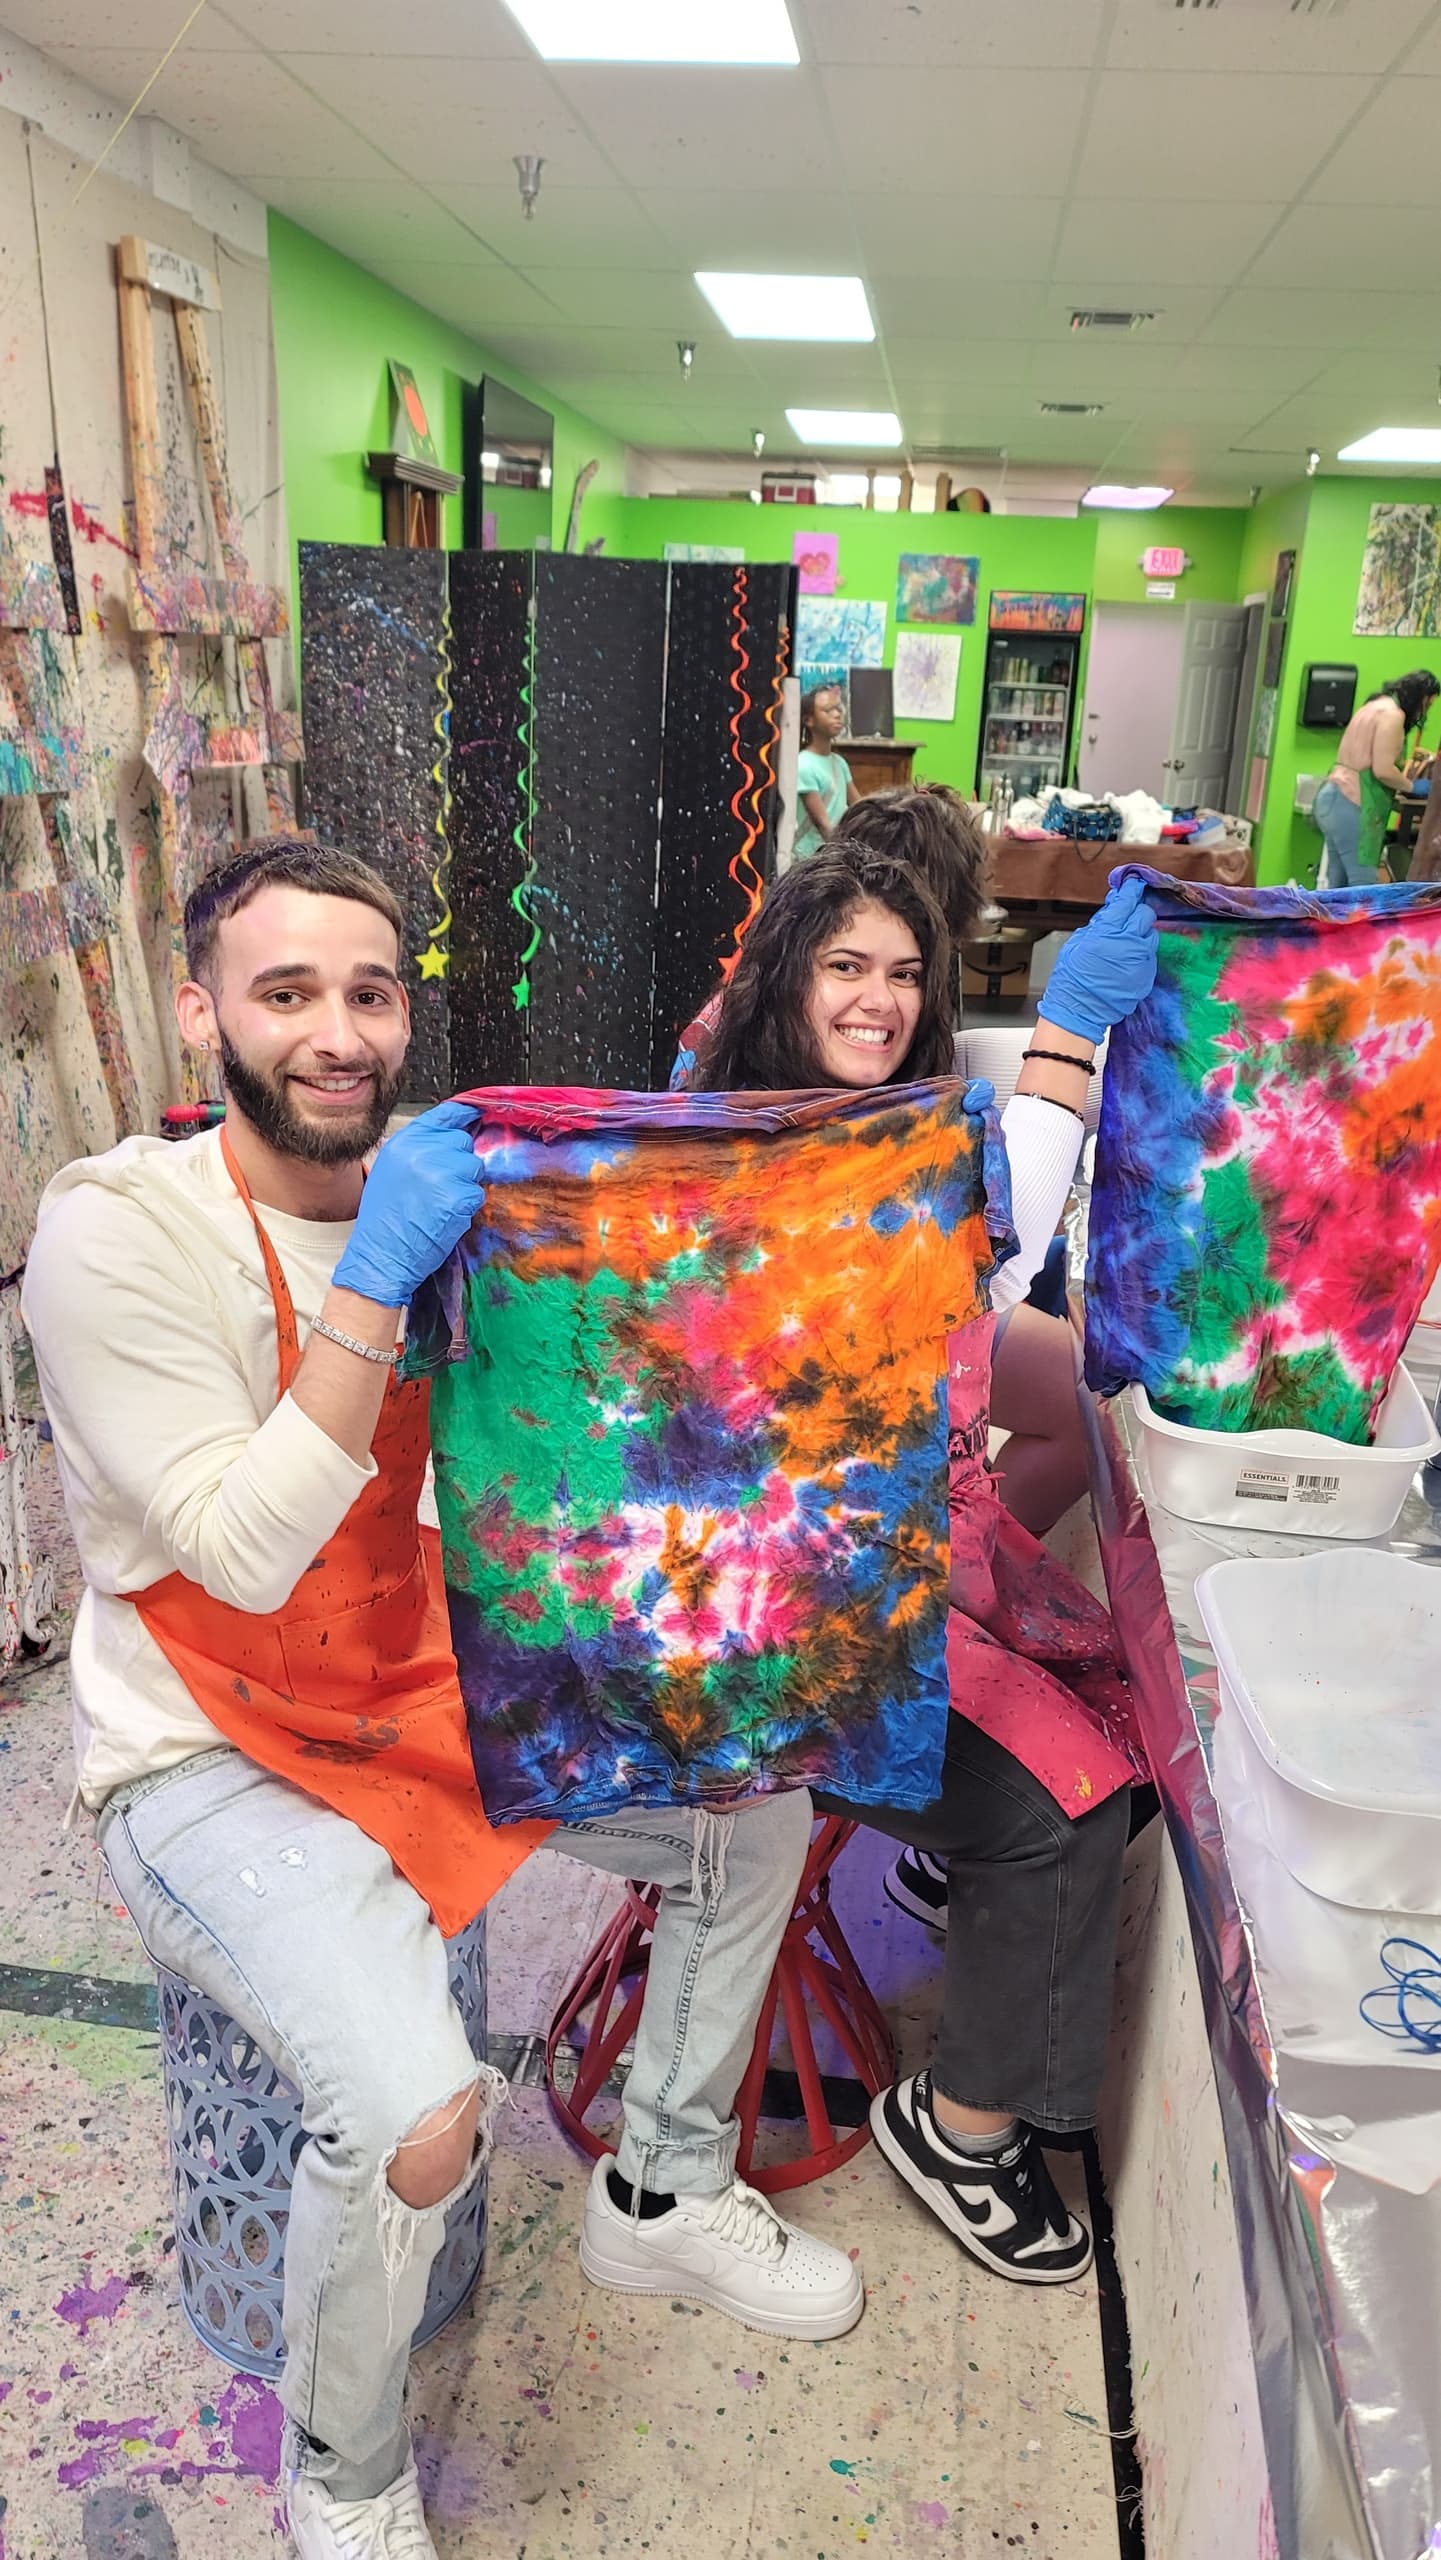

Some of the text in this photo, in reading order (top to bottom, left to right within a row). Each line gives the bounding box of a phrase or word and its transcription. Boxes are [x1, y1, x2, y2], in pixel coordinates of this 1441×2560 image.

[1151, 548, 1180, 569] EXIT
[1243, 1472, 1287, 1482] ESSENTIALS
[915, 2070, 929, 2095] NIKE
